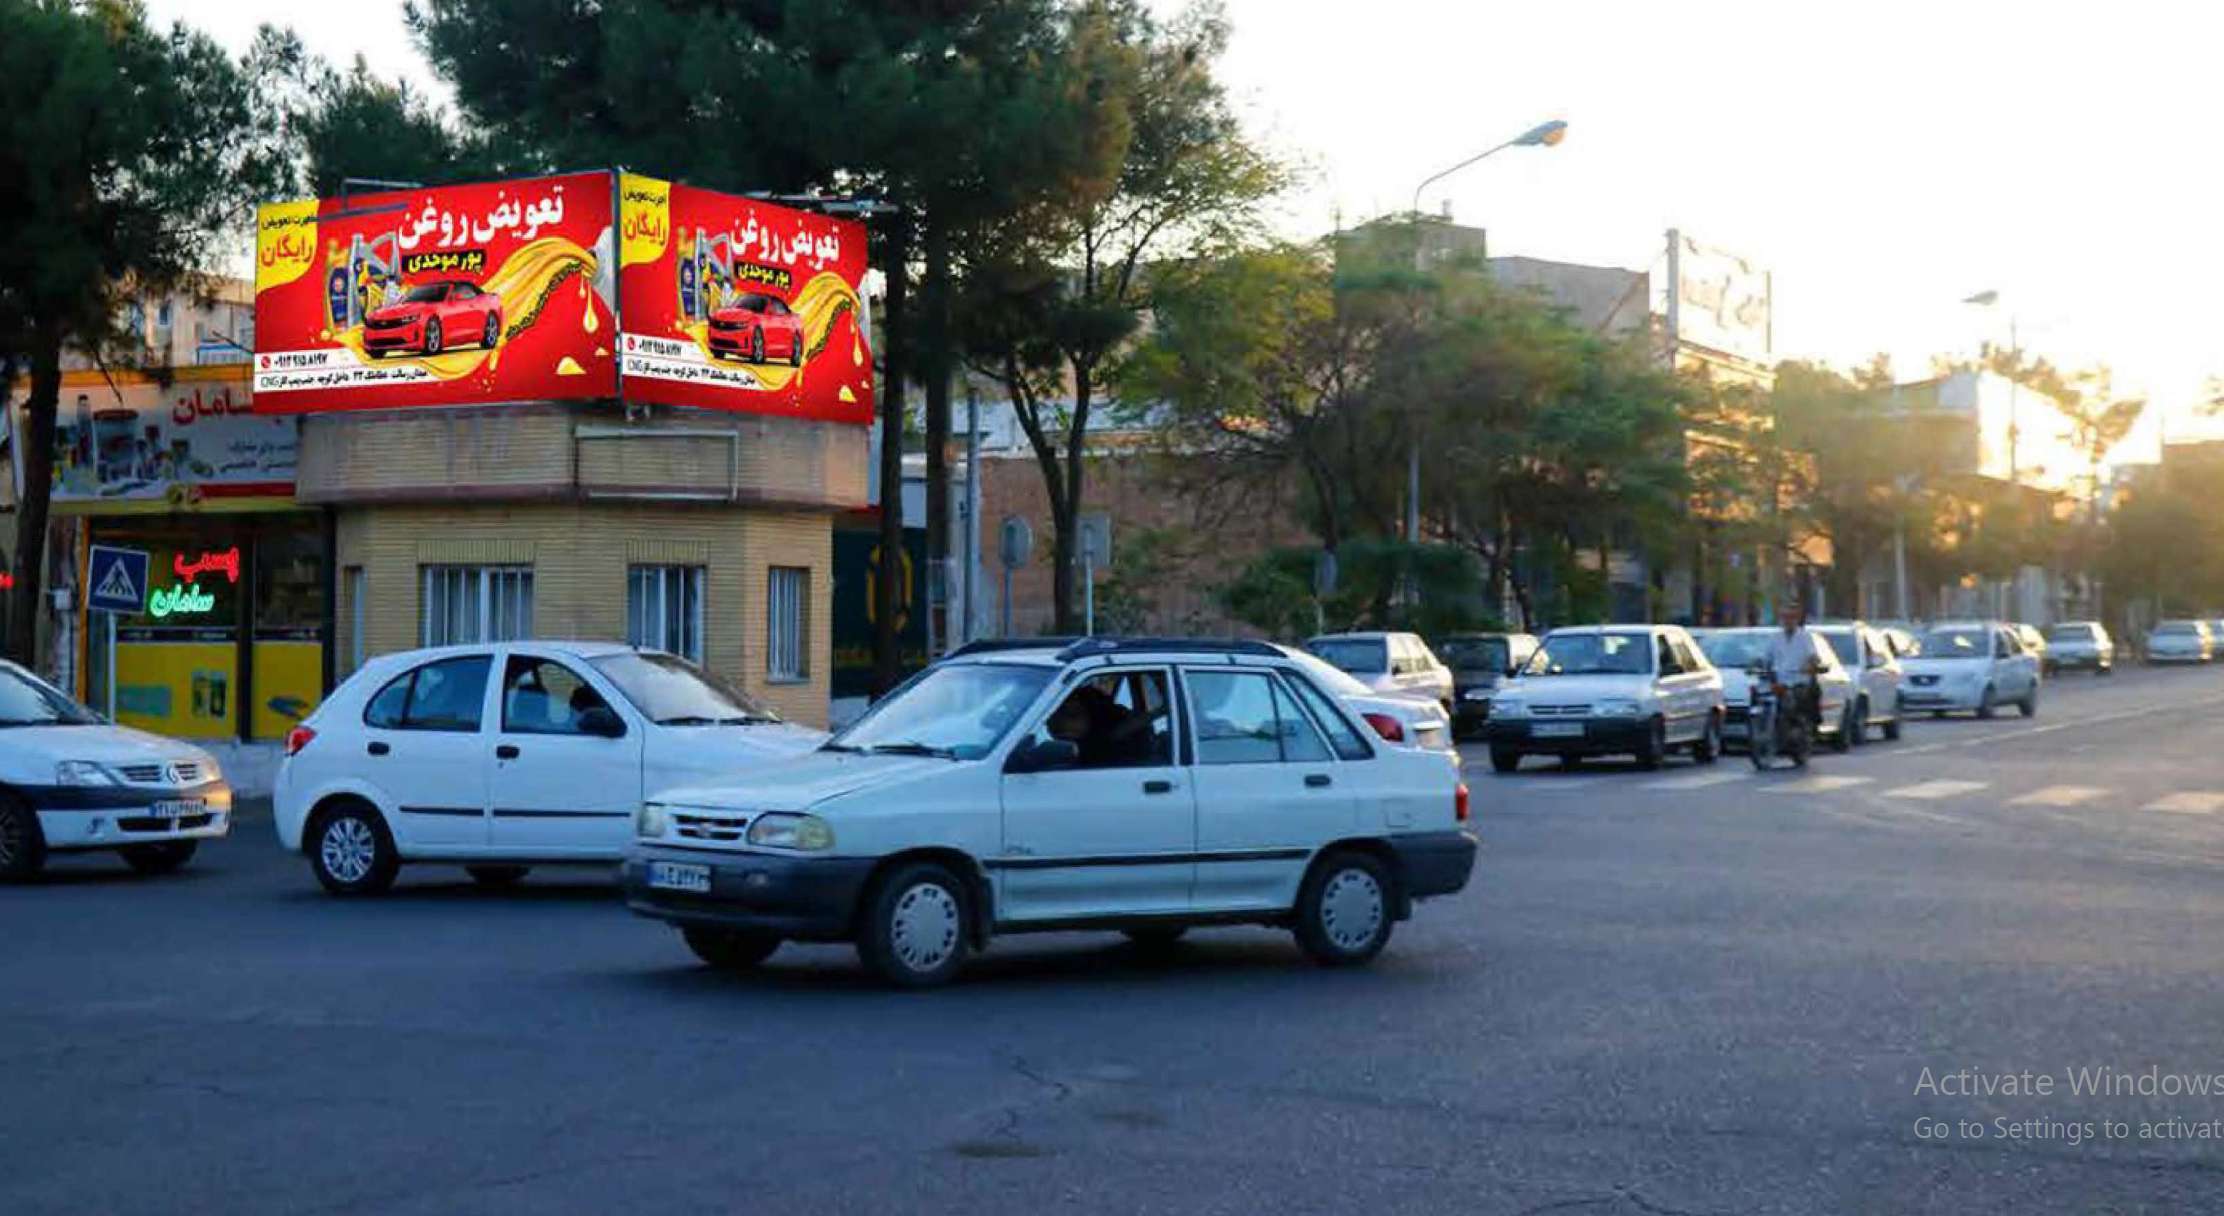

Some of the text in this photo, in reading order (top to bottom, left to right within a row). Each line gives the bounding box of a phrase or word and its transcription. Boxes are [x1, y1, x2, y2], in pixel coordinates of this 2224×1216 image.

[398, 184, 564, 250] تعویض روغن
[621, 210, 666, 247] رایگان
[260, 232, 313, 268] رایگان
[730, 208, 840, 271] تعویض روغن
[408, 251, 483, 276] پور موحدی
[150, 583, 215, 617] سامان
